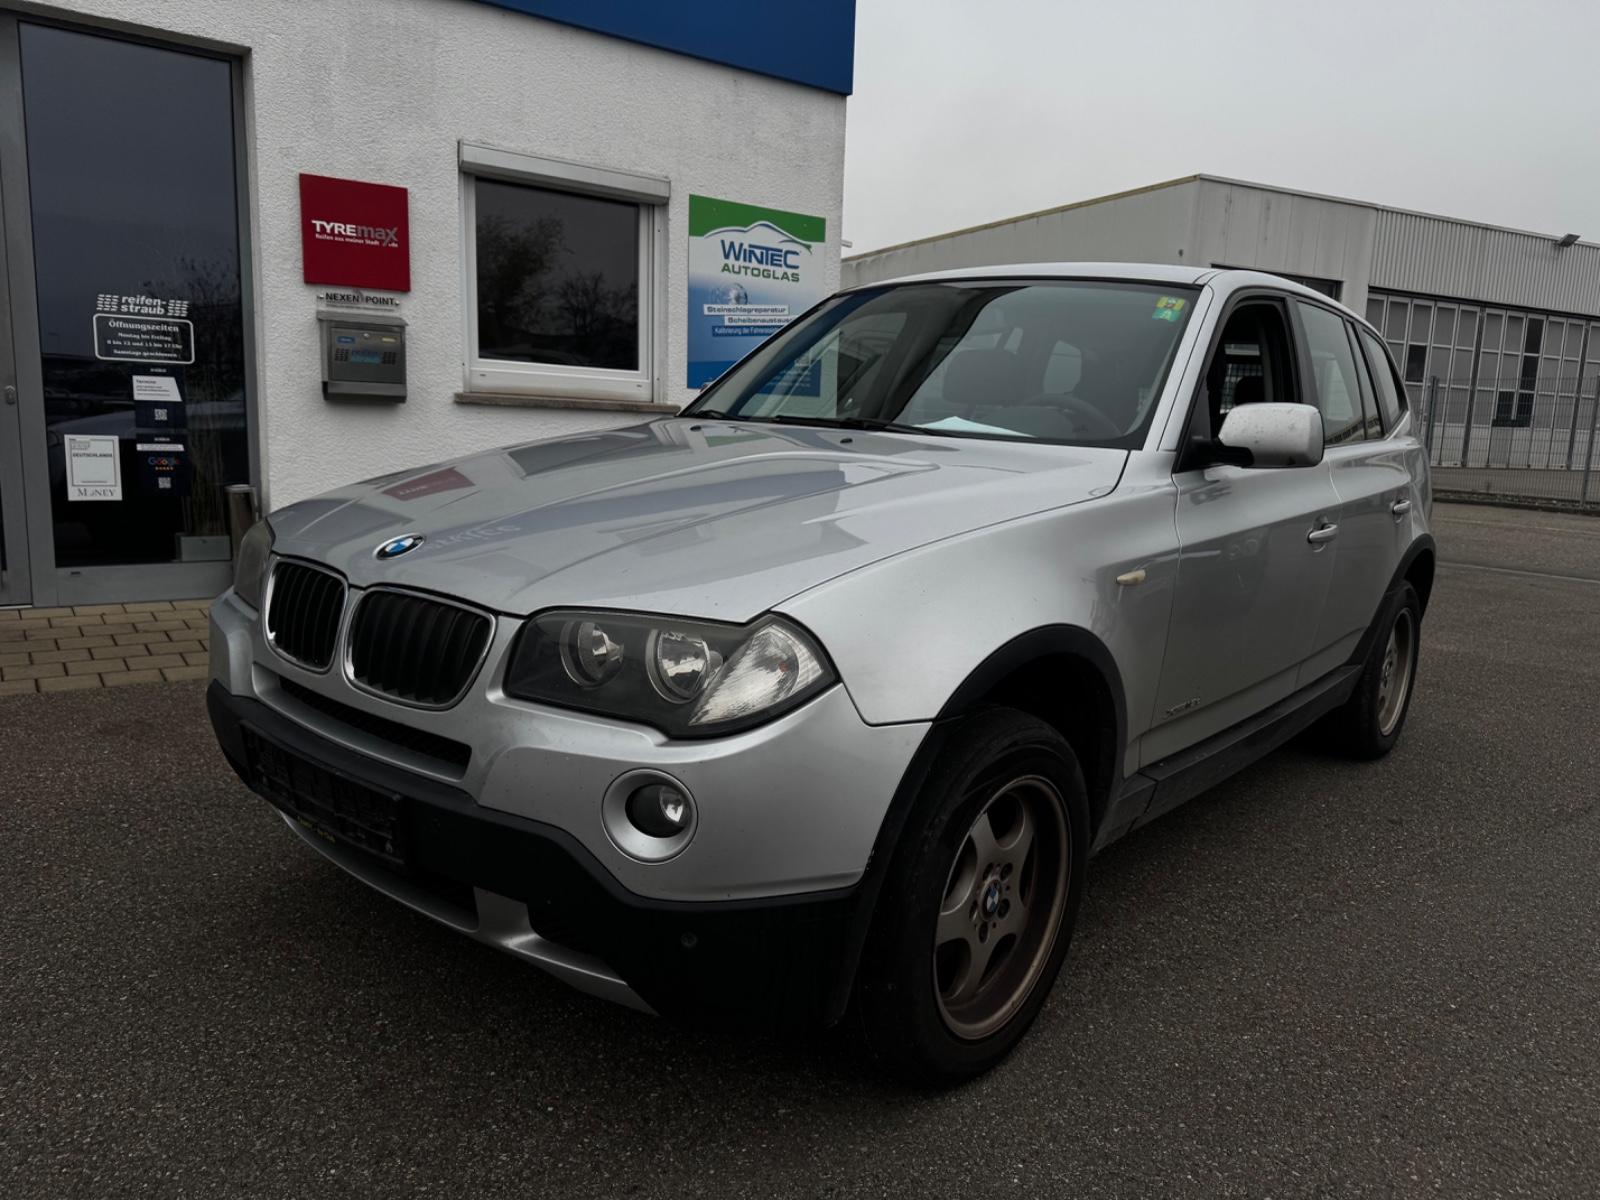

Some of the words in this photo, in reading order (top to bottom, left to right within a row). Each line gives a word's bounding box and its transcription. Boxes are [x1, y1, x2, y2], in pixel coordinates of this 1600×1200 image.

[311, 220, 399, 242] TYREmax
[721, 262, 800, 283] AUTOGLAS
[121, 295, 167, 306] reifen-
[325, 292, 360, 303] NEXEN
[365, 295, 394, 306] POINT
[120, 303, 165, 315] straub
[706, 306, 786, 314] Steinschlagreparatur
[108, 319, 179, 332] Öffnungszeiten
